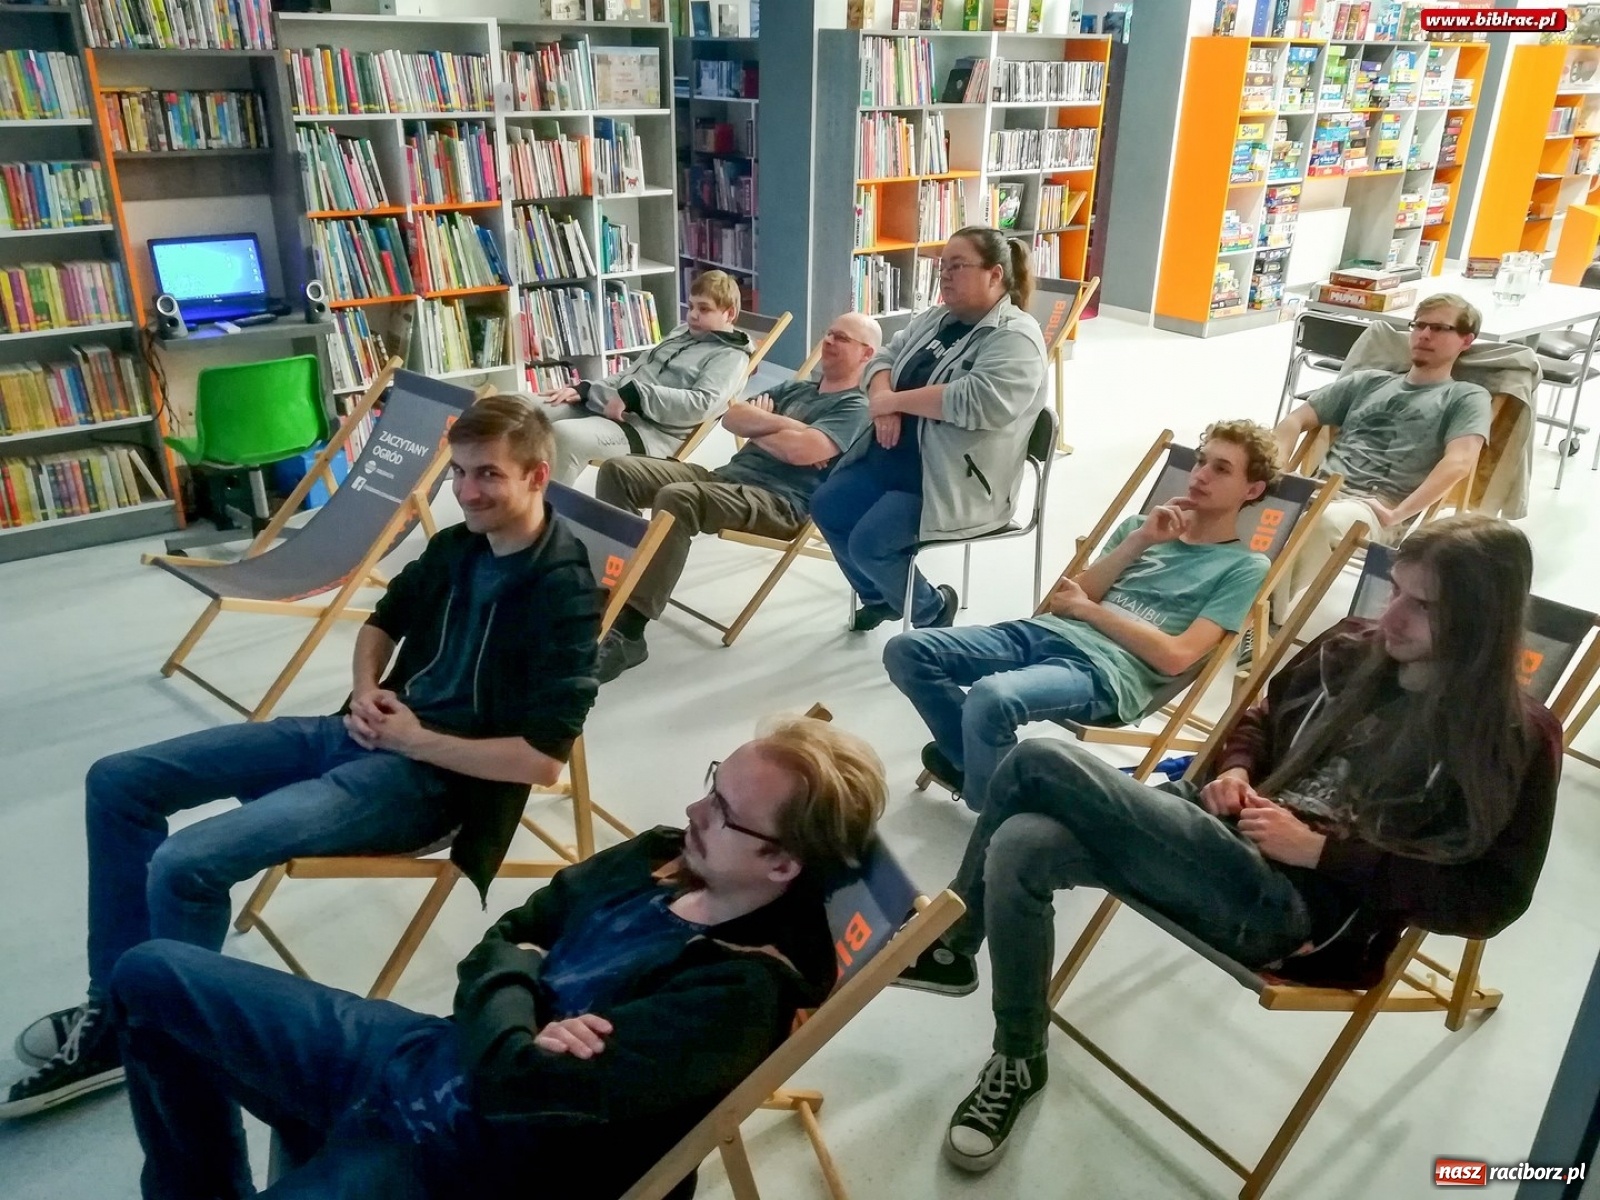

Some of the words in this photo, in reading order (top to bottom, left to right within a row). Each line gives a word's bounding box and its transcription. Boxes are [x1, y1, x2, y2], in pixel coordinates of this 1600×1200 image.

[372, 445, 403, 465] OGRÓD
[379, 430, 429, 457] ZACZYTANY
[1250, 508, 1285, 552] BIB
[1112, 593, 1168, 626] MALIBU
[836, 911, 873, 977] BI
